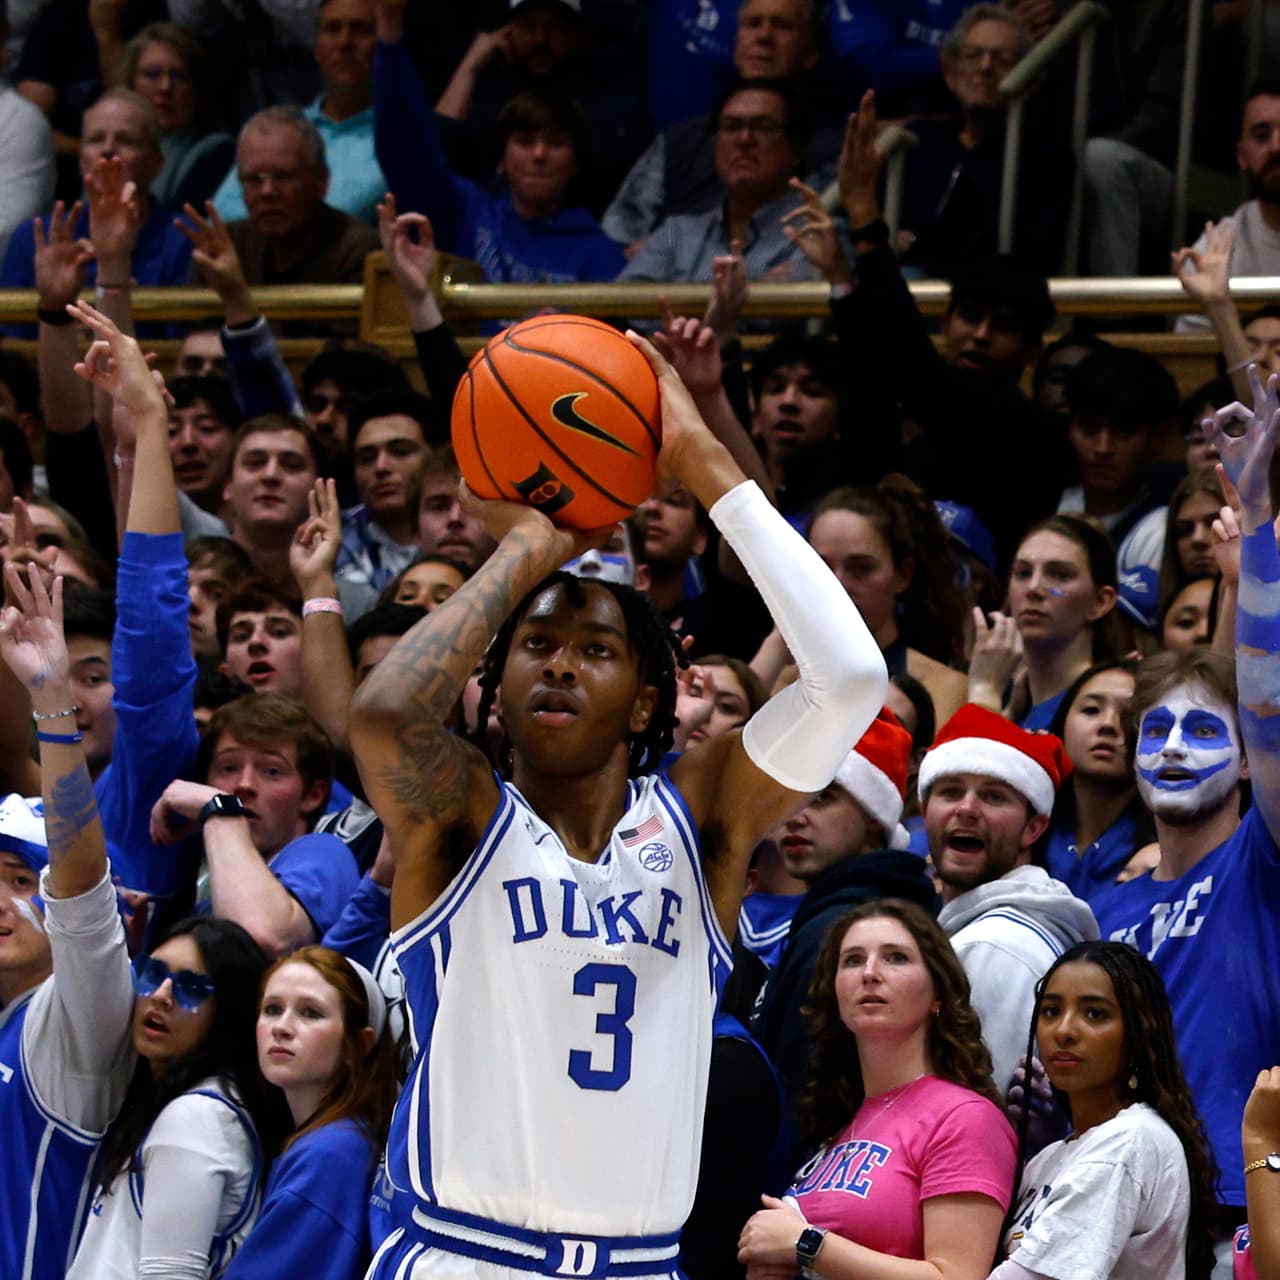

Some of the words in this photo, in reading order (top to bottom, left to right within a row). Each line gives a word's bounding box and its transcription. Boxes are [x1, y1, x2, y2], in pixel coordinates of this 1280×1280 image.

[645, 849, 669, 864] ACC
[503, 876, 682, 958] DUKE
[568, 962, 637, 1092] 3
[556, 1239, 597, 1276] D
